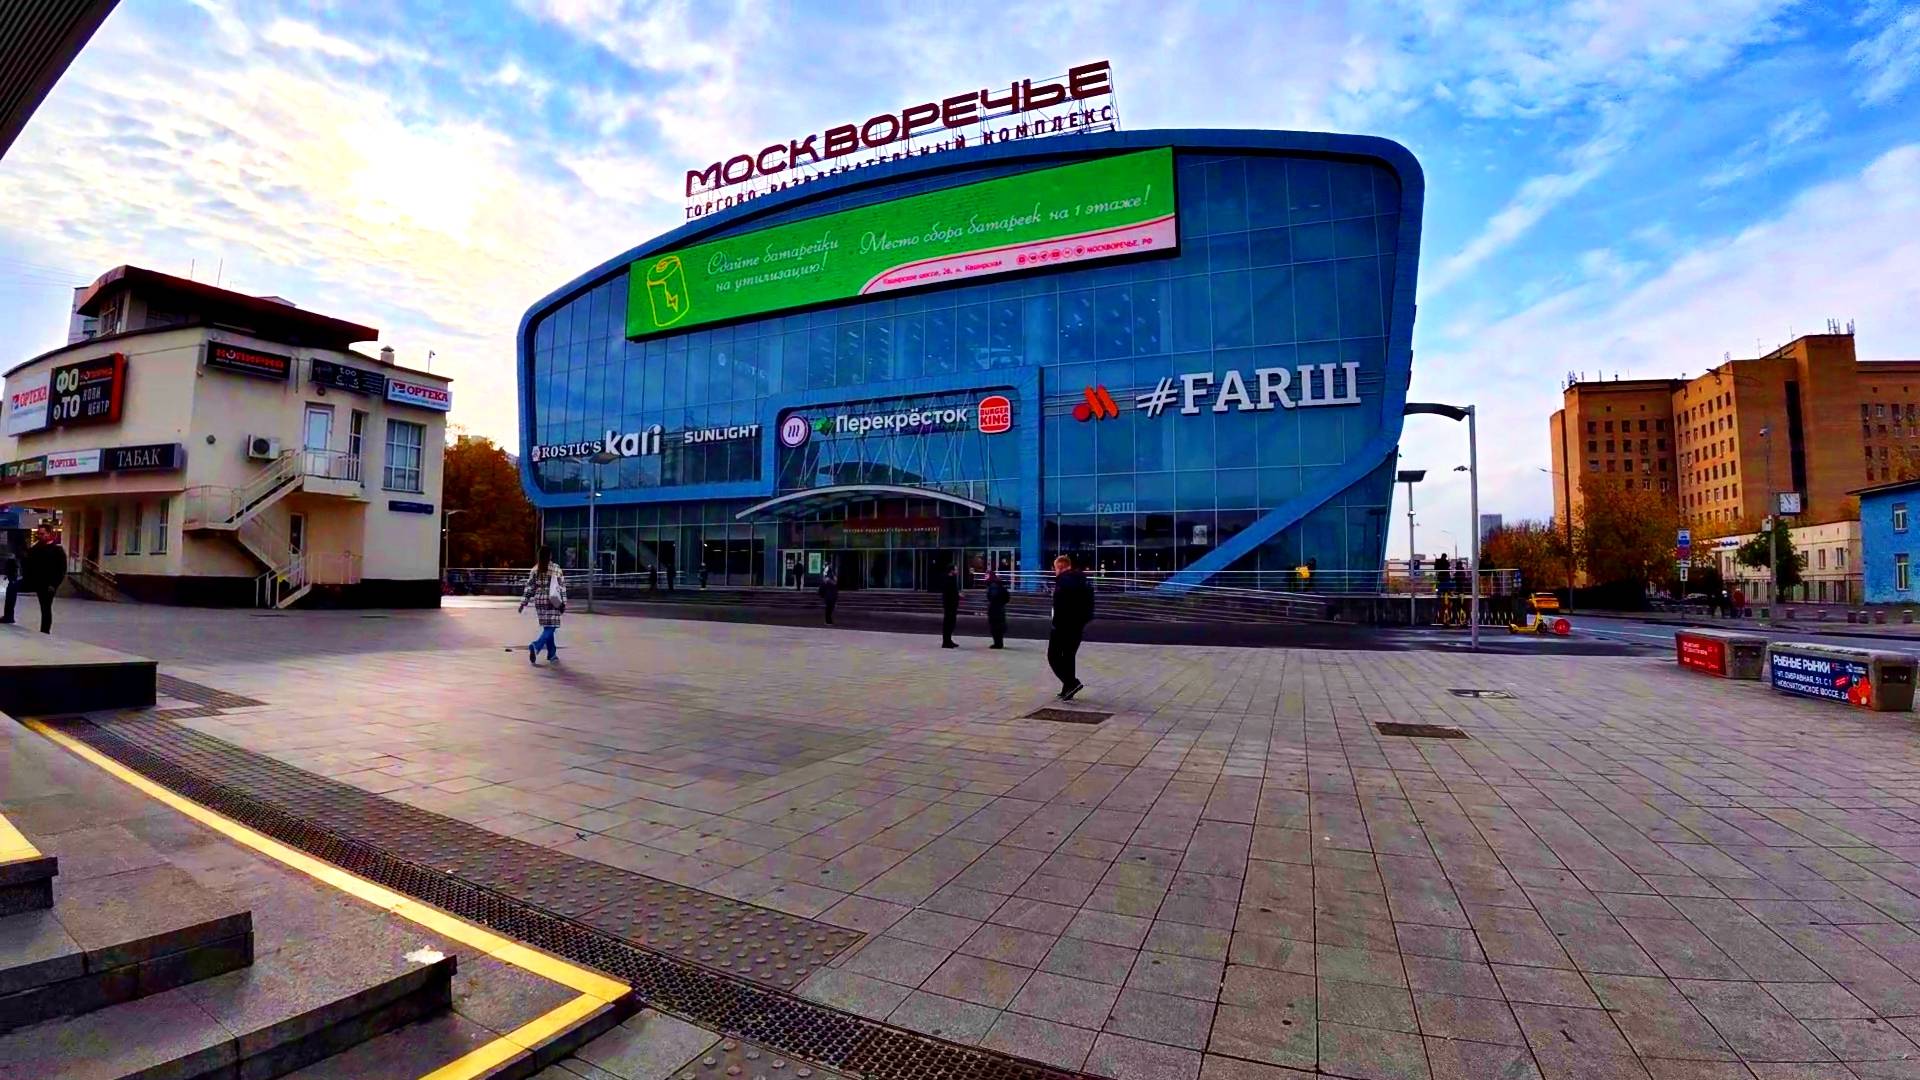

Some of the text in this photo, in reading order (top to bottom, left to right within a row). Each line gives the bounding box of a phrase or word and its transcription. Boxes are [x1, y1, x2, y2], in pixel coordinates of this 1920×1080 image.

[685, 60, 1112, 197] МОСКВОРЕЧЬЕ
[983, 105, 1112, 145] КОМПЛЕКС
[859, 231, 920, 255] Место
[967, 203, 1041, 235] батареек
[1049, 208, 1069, 221] на
[1074, 205, 1081, 218] 1
[1085, 184, 1151, 215] этаже!
[707, 231, 839, 275] Сдайте батарейки
[716, 251, 828, 292] на утилизацию!
[56, 368, 79, 394] ФО
[407, 386, 449, 402] ОРТЕКА
[88, 400, 110, 416] ЦЕНТР
[980, 407, 1009, 416] BURGER
[981, 414, 1009, 425] KING
[835, 407, 968, 434] Перекрёсток
[605, 424, 662, 457] kari
[684, 424, 759, 444] SUNLIGHT
[117, 447, 161, 467] ТАБАК
[541, 440, 602, 459] ROSTIC'S
[1773, 654, 1802, 670] РЫБНЫЕ
[1802, 658, 1831, 674] РЫНКИ
